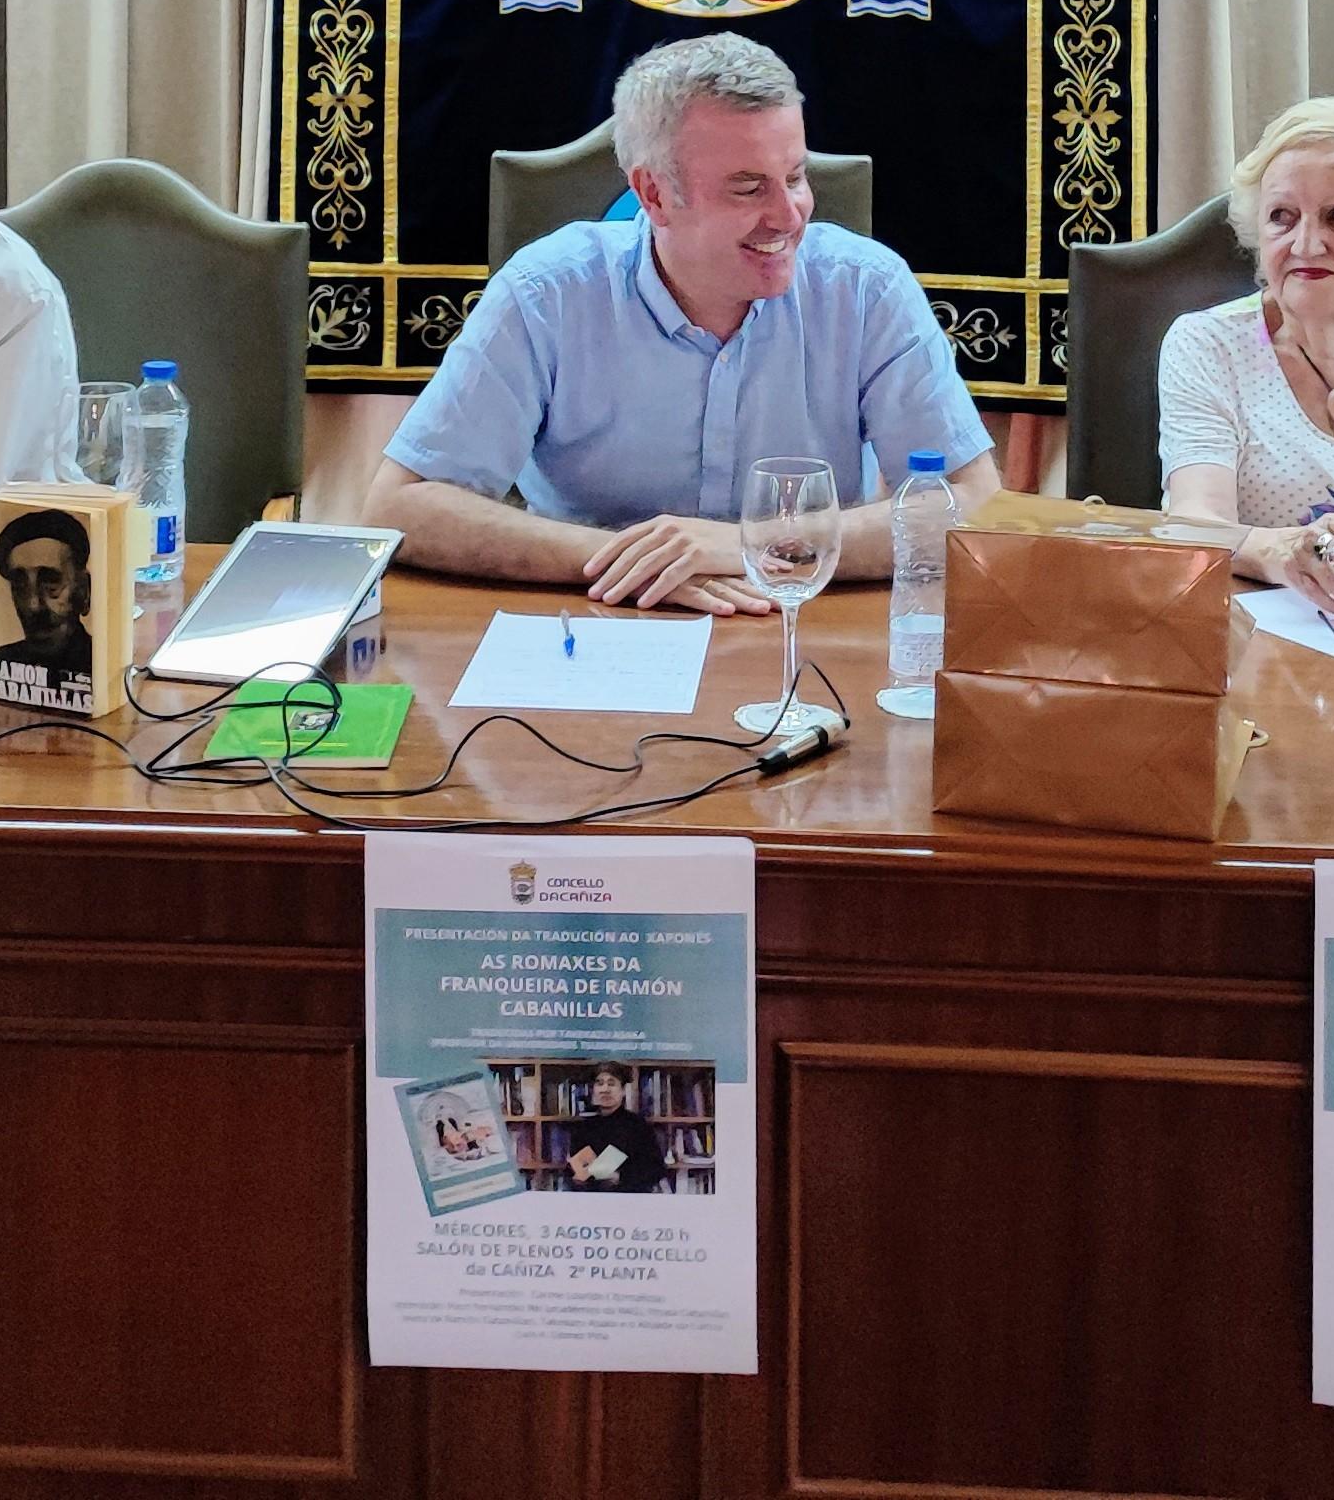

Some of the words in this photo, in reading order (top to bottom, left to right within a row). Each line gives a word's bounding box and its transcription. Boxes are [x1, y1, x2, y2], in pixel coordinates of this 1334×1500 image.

[619, 932, 639, 943] AO
[481, 955, 505, 970] AS
[512, 955, 606, 972] ROMAXES
[613, 957, 640, 972] DA
[441, 977, 567, 994] FRANQUEIRA
[575, 979, 598, 994] DE
[605, 977, 682, 996] RAMÓN
[500, 1002, 623, 1018] CABANILLAS
[540, 1226, 550, 1240] 3
[555, 1227, 625, 1240] AGOSTO
[655, 1228, 674, 1241] 20
[416, 1240, 475, 1256] SALÓN
[481, 1244, 500, 1257] DE
[507, 1245, 574, 1259] PLENOS
[584, 1246, 609, 1260] DO
[616, 1247, 707, 1262] CONCELLO
[492, 1262, 554, 1277] CAÑIZA
[590, 1266, 659, 1280] PLANTA
